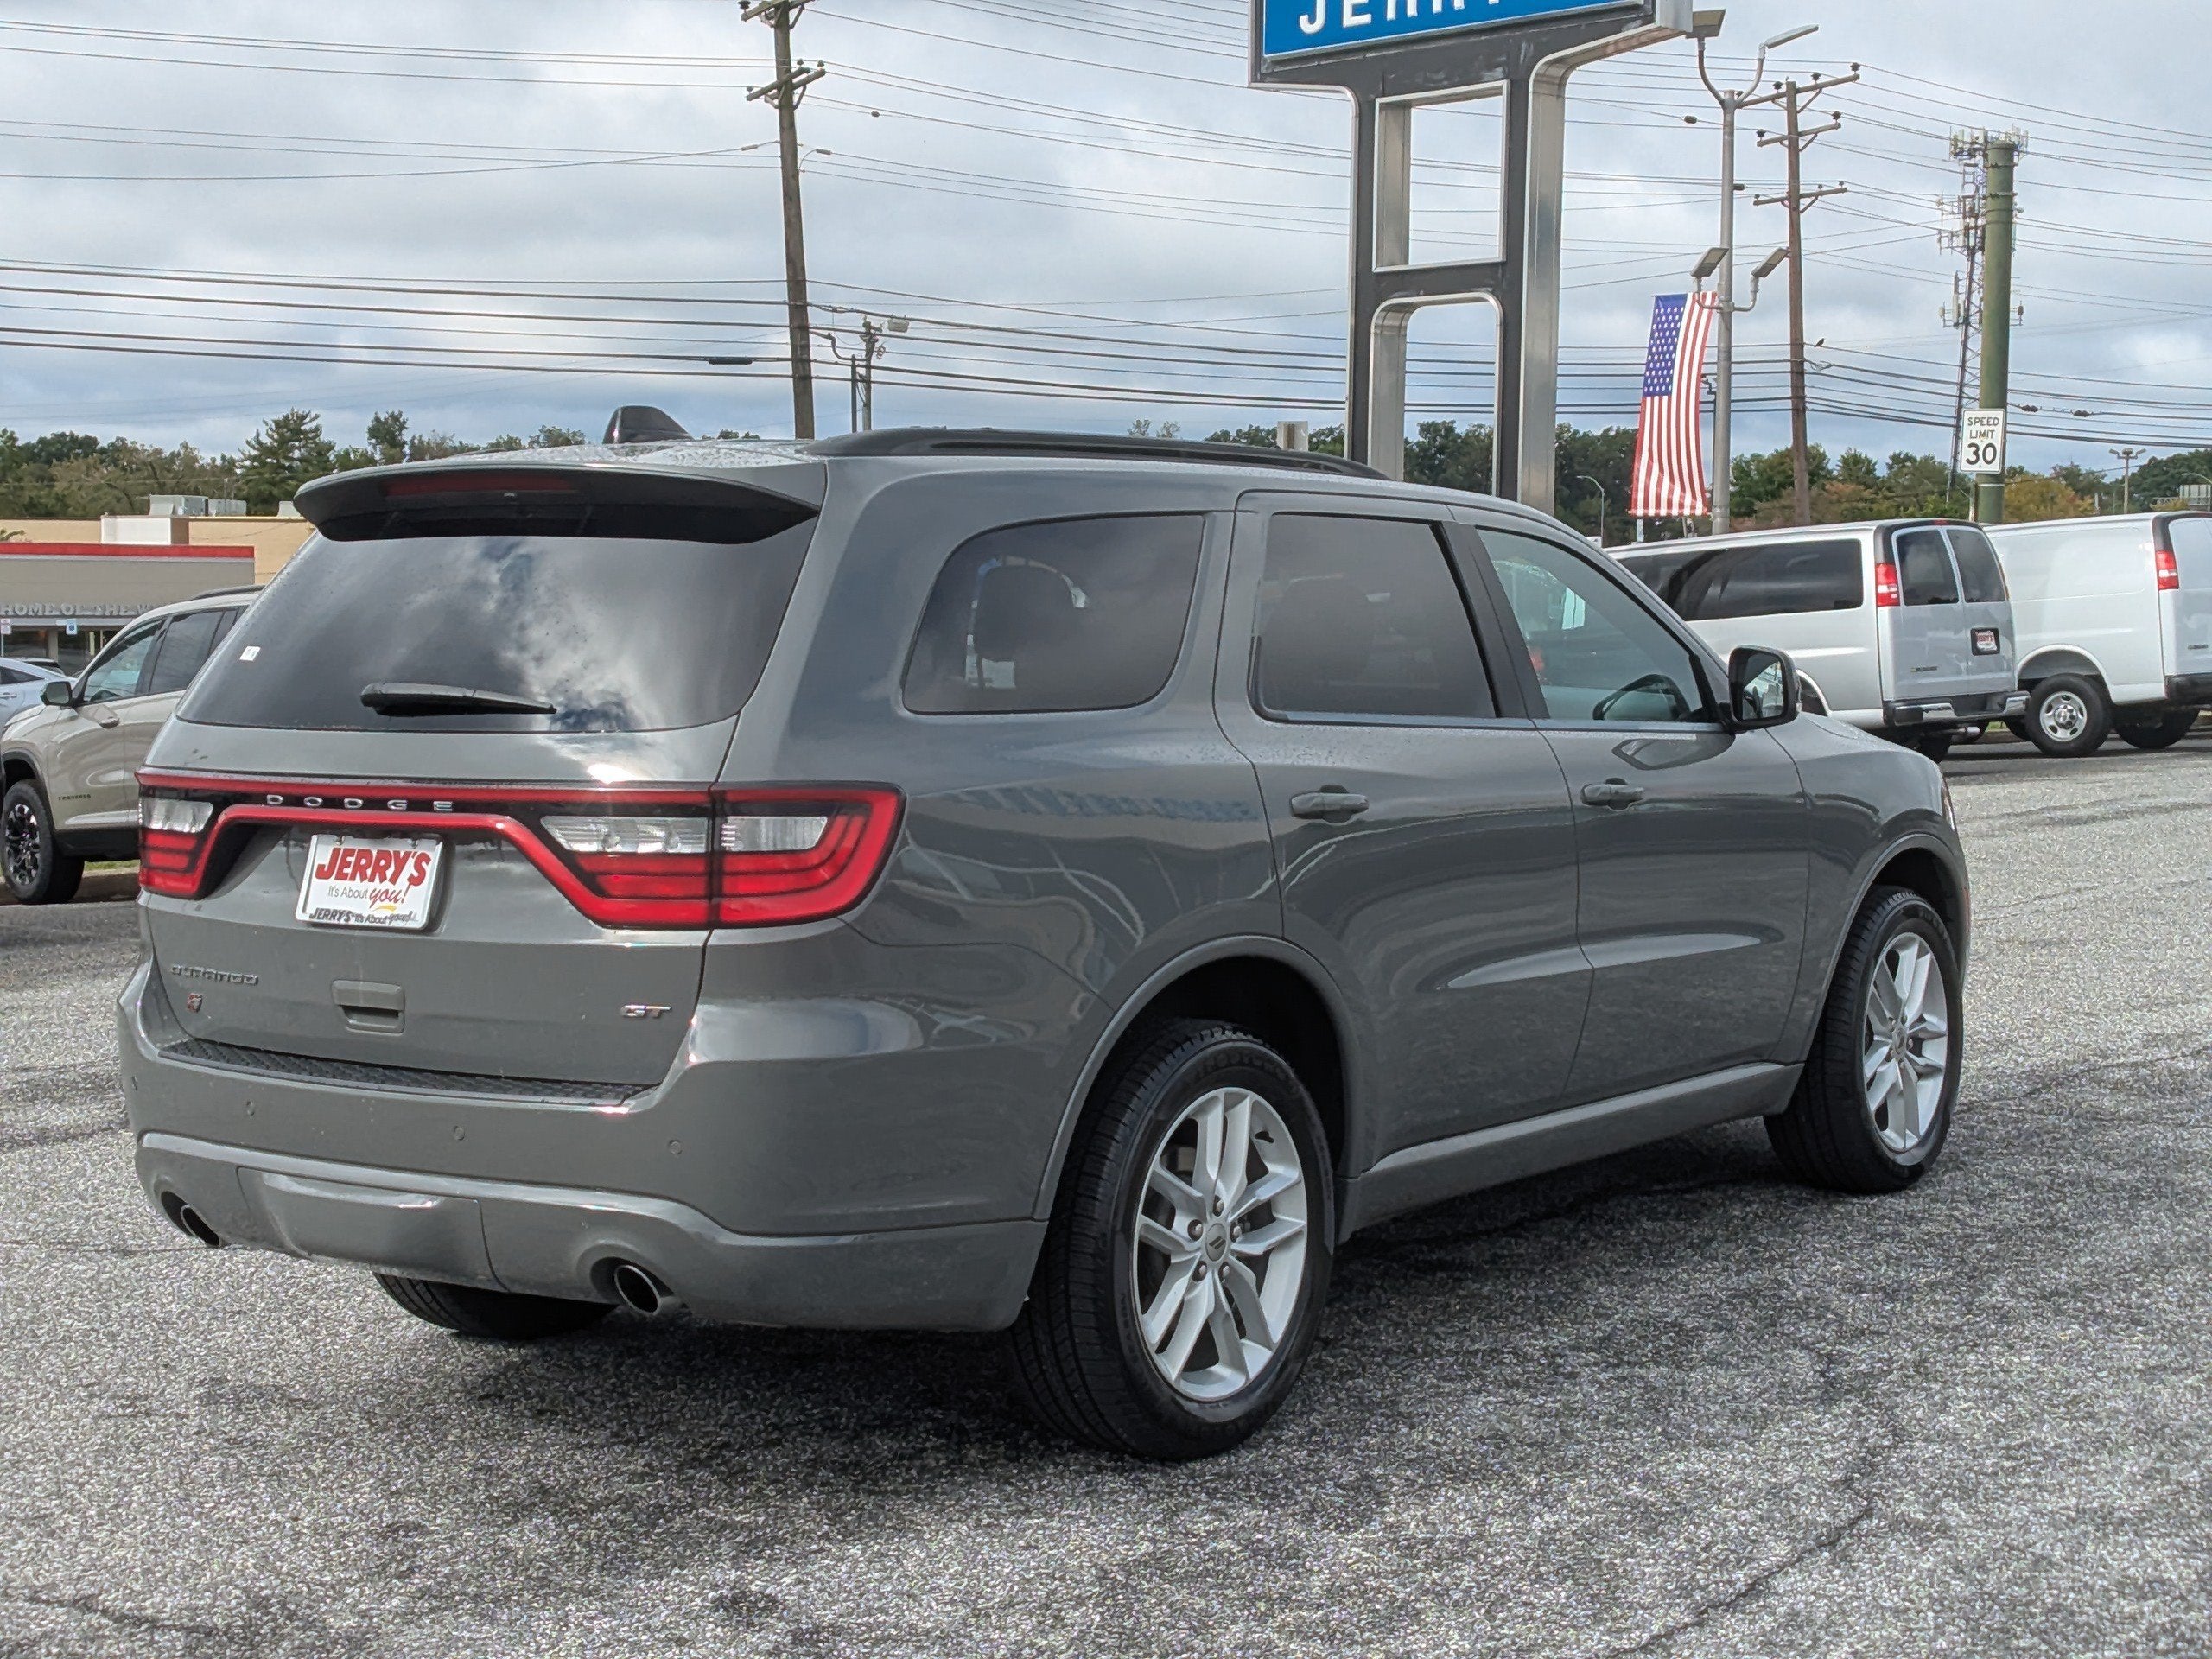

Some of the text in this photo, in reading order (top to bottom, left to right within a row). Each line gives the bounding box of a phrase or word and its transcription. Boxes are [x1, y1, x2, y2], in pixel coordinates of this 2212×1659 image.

[1967, 416, 1999, 427] SPEED
[1969, 429, 1995, 439] LIMIT
[1965, 442, 1997, 465] 30
[266, 794, 453, 811] DODGE
[315, 847, 432, 887] JERRY'S
[327, 882, 411, 908] It's About you!
[620, 1005, 671, 1018] GT
